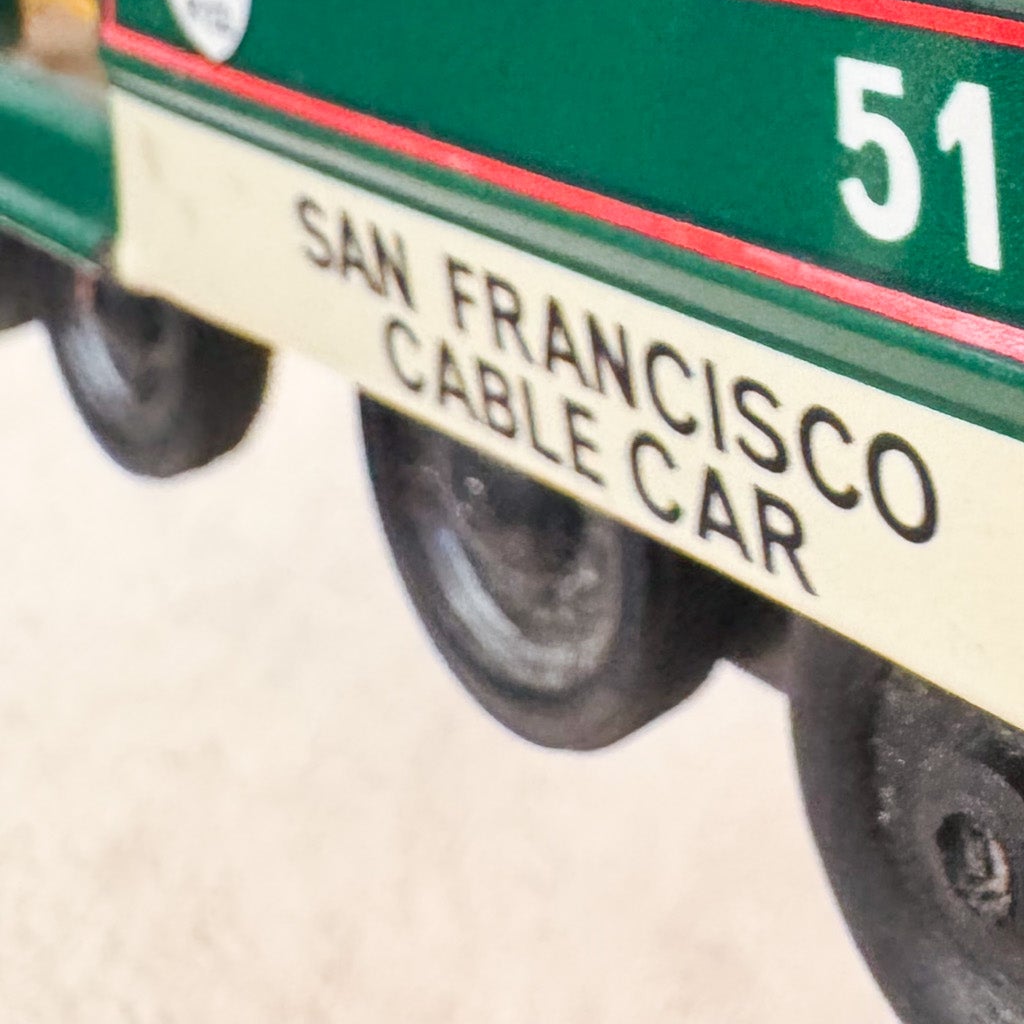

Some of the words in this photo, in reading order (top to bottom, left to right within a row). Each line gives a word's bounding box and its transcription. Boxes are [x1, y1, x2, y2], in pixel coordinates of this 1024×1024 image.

[293, 194, 417, 311] SAN
[444, 252, 939, 545] FRANCISCO
[384, 320, 606, 489] CABLE
[630, 431, 820, 597] CAR
